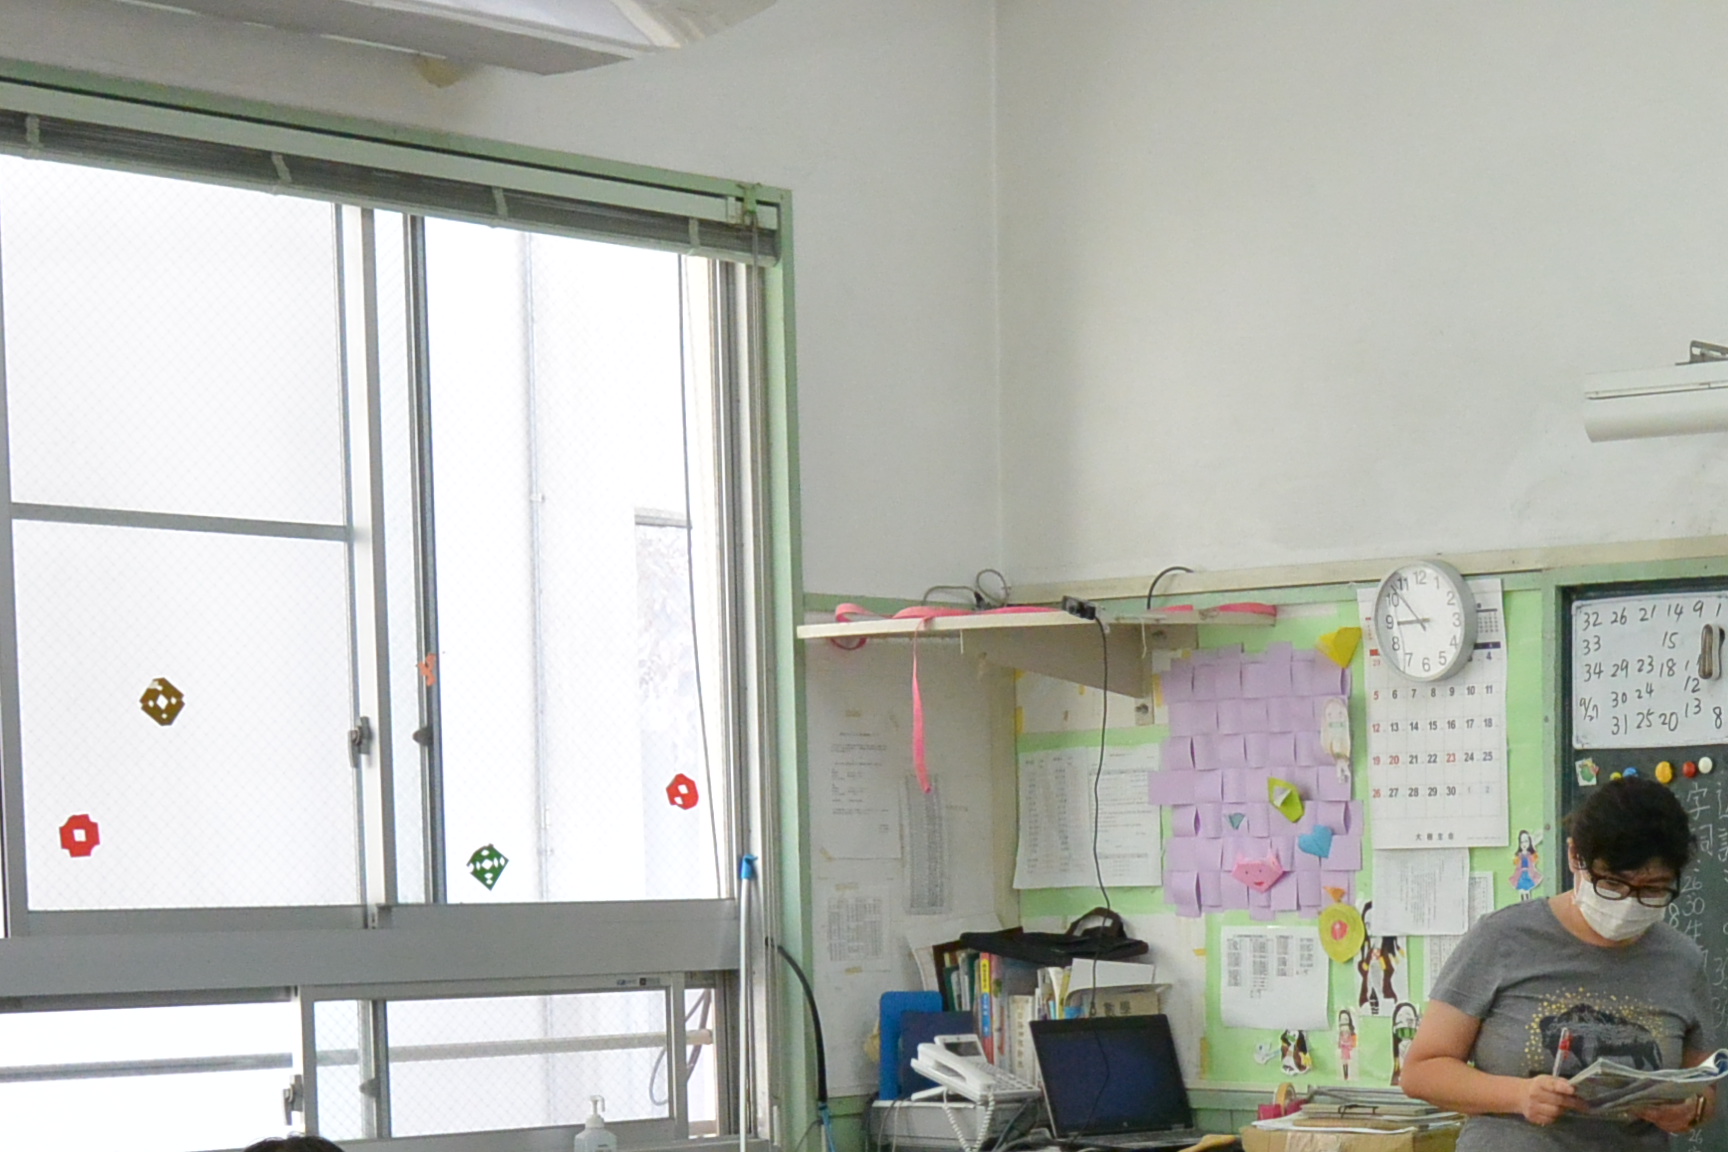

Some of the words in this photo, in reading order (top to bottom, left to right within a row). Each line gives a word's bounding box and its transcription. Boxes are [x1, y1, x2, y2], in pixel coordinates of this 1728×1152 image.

[1396, 576, 1410, 592] 11
[1412, 569, 1428, 586] 12
[1433, 574, 1441, 591] 1
[1386, 591, 1400, 609] 10
[1446, 589, 1457, 607] 2
[1384, 613, 1395, 631] 9
[1451, 611, 1462, 629] 3
[1583, 611, 1602, 631] 32
[1611, 607, 1627, 625] 26
[1639, 605, 1656, 622] 21
[1667, 603, 1684, 622] 14
[1693, 600, 1704, 617] 9
[1716, 603, 1721, 616] 1
[1391, 634, 1401, 653] 8
[1449, 634, 1459, 651] 4
[1583, 635, 1601, 655] 33
[1662, 631, 1678, 649] 15
[1405, 651, 1414, 669] 7
[1421, 656, 1432, 673] 6
[1437, 649, 1448, 667] 5
[1485, 651, 1493, 661] 4
[1584, 662, 1604, 682] 34
[1611, 659, 1629, 678] 29
[1637, 655, 1654, 673] 23
[1660, 658, 1676, 677] 18
[1373, 690, 1380, 701] 5
[1391, 689, 1398, 700] 6
[1411, 688, 1417, 699] 7
[1428, 687, 1437, 698] 8
[1448, 686, 1455, 697] 9
[1465, 684, 1476, 696] 10
[1484, 684, 1493, 695] 11
[1684, 674, 1702, 693] 12
[1611, 691, 1627, 708] 30
[1635, 683, 1654, 699] 24
[1685, 698, 1701, 718] 13
[1372, 722, 1381, 733] 12
[1390, 721, 1400, 733] 13
[1409, 721, 1419, 732] 14
[1428, 720, 1438, 731] 15
[1446, 719, 1457, 730] 16
[1465, 718, 1475, 729] 17
[1483, 717, 1493, 728] 18
[1612, 714, 1627, 735] 31
[1636, 710, 1654, 729] 25
[1659, 712, 1678, 731] 20
[1713, 706, 1722, 729] 8
[1372, 755, 1381, 766] 19
[1388, 754, 1400, 765] 20
[1408, 754, 1419, 765] 21
[1427, 753, 1438, 764] 22
[1446, 752, 1457, 764] 23
[1463, 751, 1475, 763] 24
[1482, 750, 1494, 762] 25
[1372, 788, 1382, 799] 26
[1388, 787, 1400, 798] 27
[1407, 787, 1419, 798] 28
[1427, 786, 1438, 797] 29
[1446, 785, 1457, 797] 30
[1681, 875, 1703, 893] 26
[1682, 897, 1705, 917] 30
